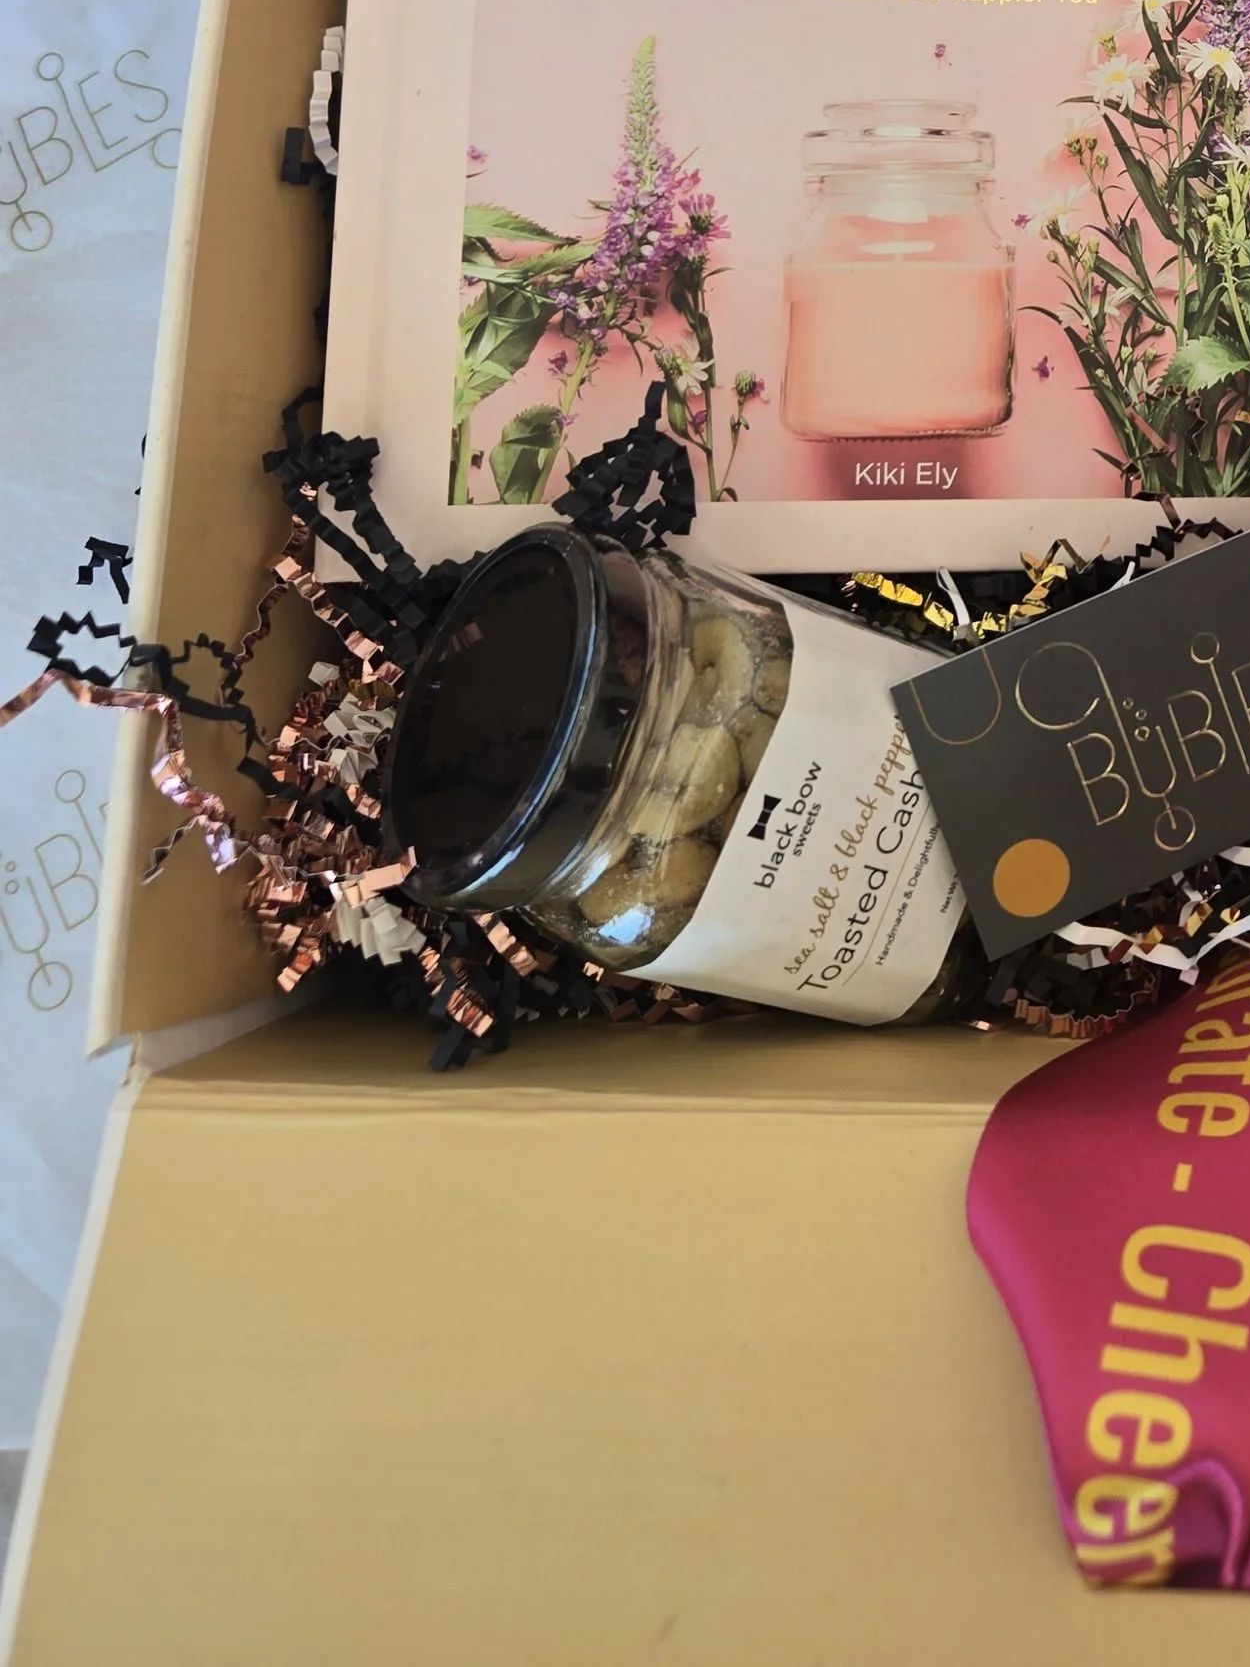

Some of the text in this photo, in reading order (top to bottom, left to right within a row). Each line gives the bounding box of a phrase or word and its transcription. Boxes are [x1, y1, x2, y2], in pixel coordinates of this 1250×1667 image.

[854, 460, 959, 490] Kiki Ely
[752, 760, 823, 889] black bow
[783, 714, 912, 976] sea salt & black peppe
[792, 801, 823, 858] sweets
[796, 864, 890, 991] Toasted
[874, 900, 909, 967] Handmade
[903, 889, 914, 901] &
